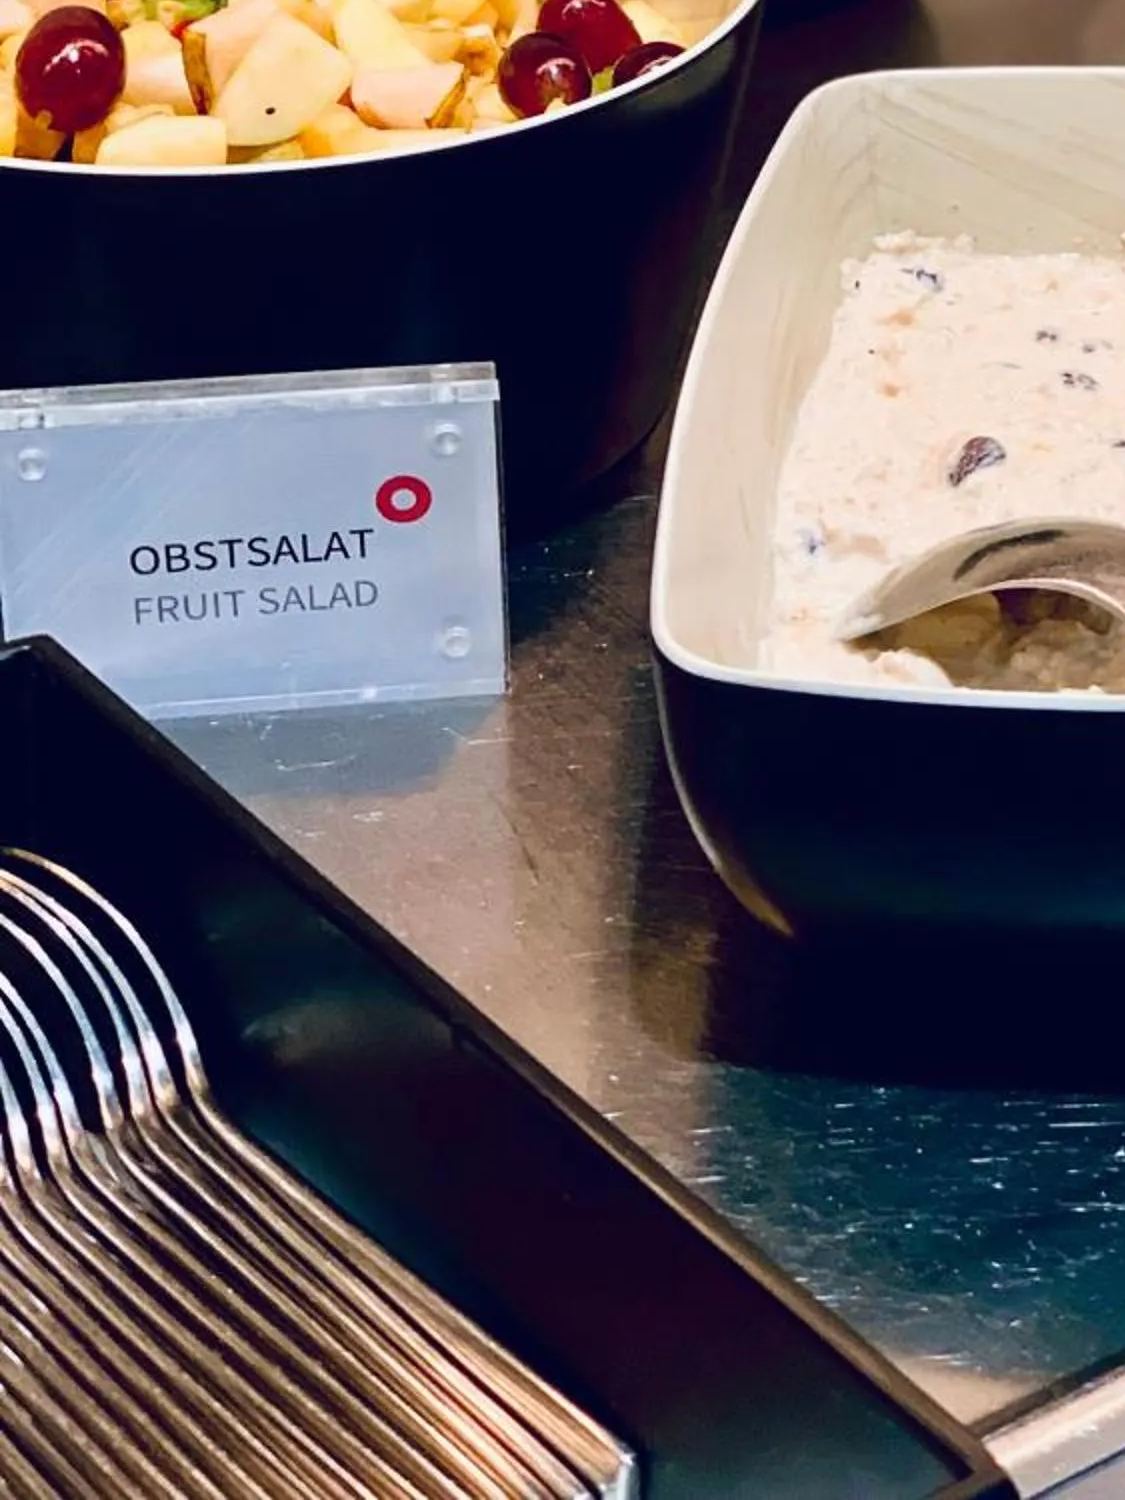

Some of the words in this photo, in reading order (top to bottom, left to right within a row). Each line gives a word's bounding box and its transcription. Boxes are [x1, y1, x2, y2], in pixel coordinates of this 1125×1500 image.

[130, 528, 375, 575] OBSTSALAT
[134, 590, 246, 624] FRUIT
[258, 580, 379, 615] SALAD
